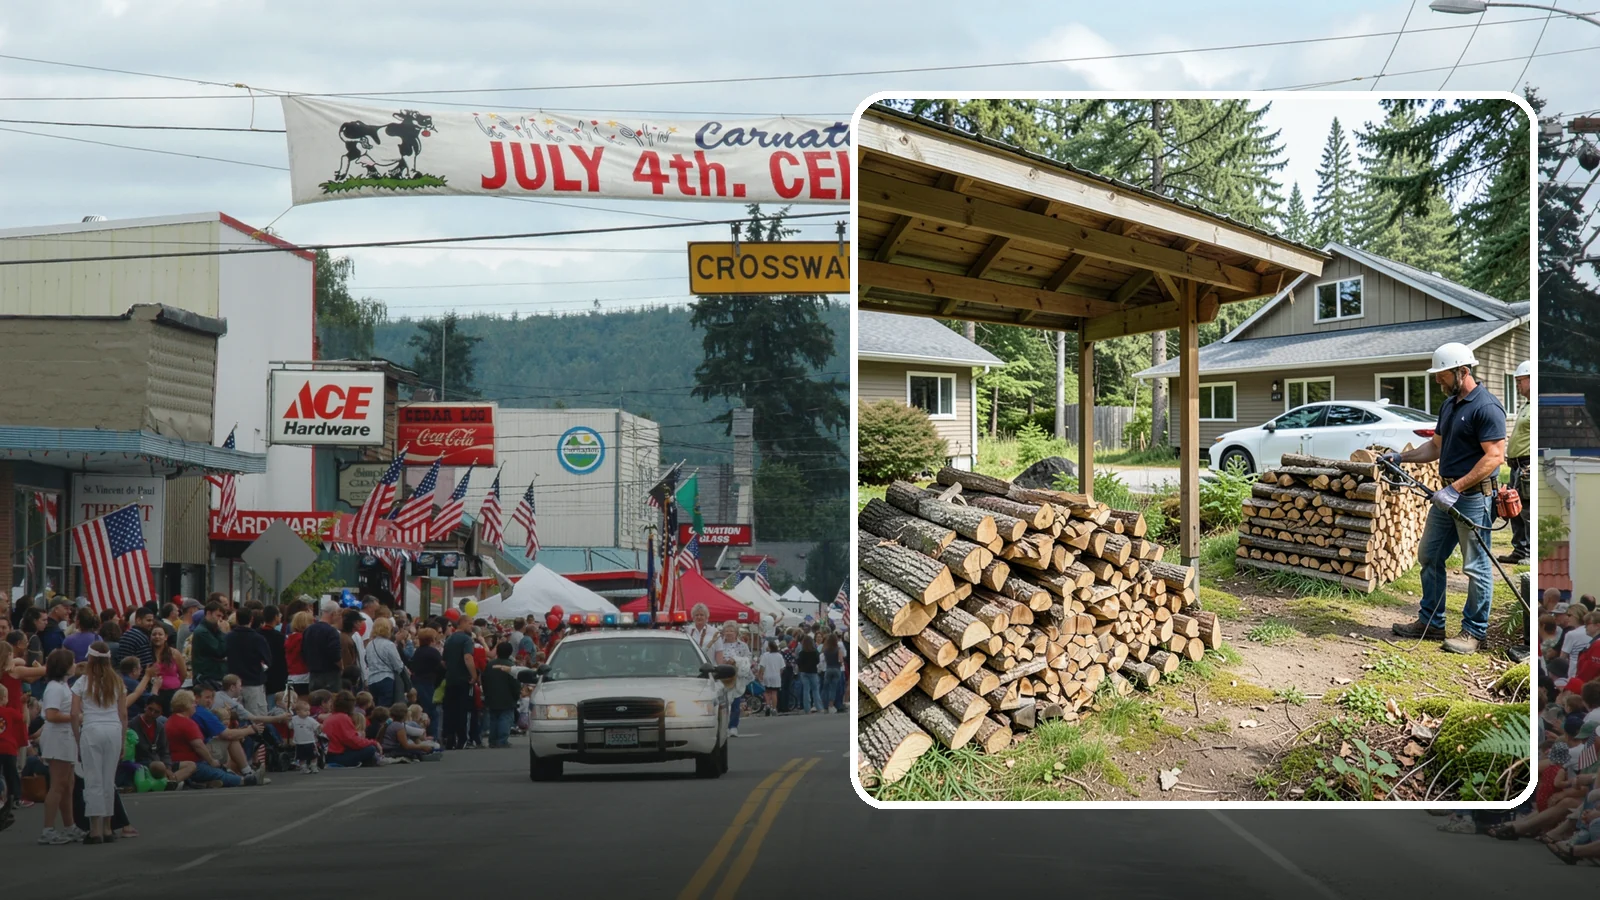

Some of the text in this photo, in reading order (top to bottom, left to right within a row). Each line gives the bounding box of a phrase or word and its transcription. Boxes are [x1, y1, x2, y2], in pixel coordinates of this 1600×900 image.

[481, 141, 605, 192] JULY
[632, 150, 746, 197] 4th.
[697, 253, 850, 280] CROSSWA
[283, 380, 374, 420] ACE
[405, 409, 485, 422] CEDAR LOG
[283, 421, 371, 436] Hardware
[416, 428, 477, 446] Coca-Cola
[83, 485, 155, 495] St. Vincent de Paul
[688, 526, 742, 535] CRNATION
[699, 535, 730, 543] GLASS
